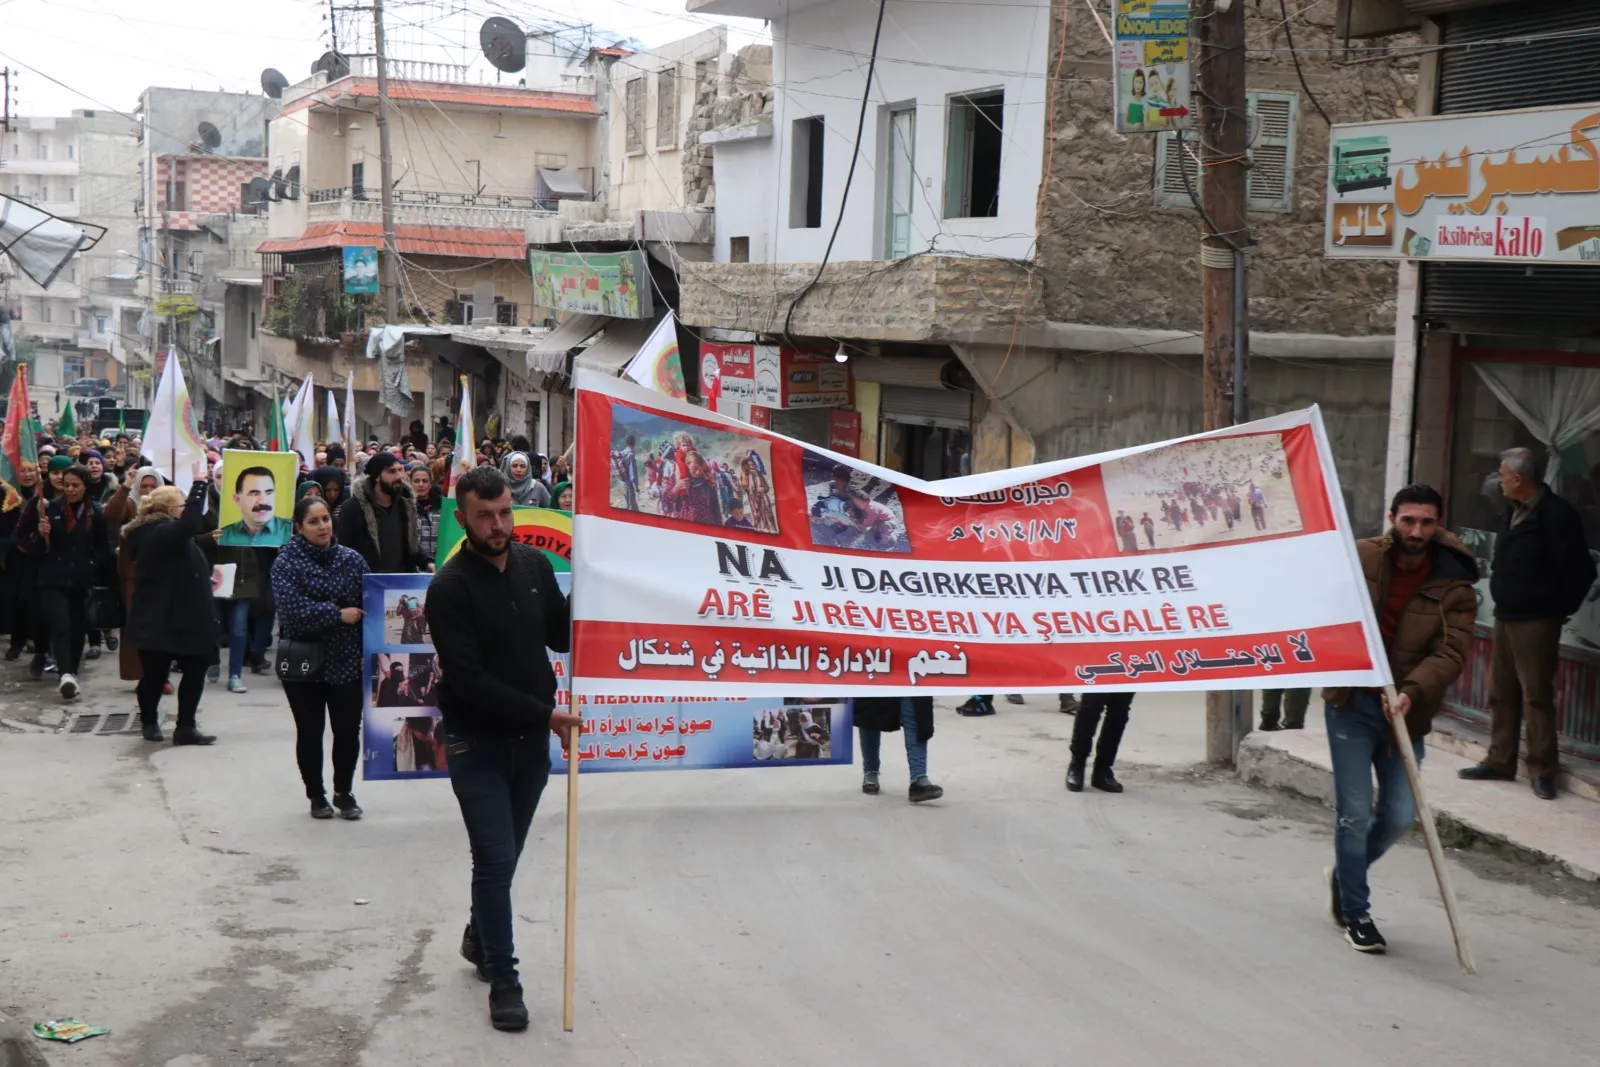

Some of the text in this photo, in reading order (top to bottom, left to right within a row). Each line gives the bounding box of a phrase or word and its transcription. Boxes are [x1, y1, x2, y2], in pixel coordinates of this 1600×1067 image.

[1117, 14, 1188, 35] KNOWLEDGE
[1335, 204, 1388, 246] كالو
[1494, 216, 1543, 258] kalo
[714, 541, 1195, 596] NA JI DAGIRKERIYA TIRK RE
[697, 588, 1230, 642] ARÊ JI RÊVEBERI YA ŞENGALÊ RE
[618, 637, 969, 685] نعم للإدارة الذاتية في شنكال
[1288, 632, 1316, 662] لا
[1075, 650, 1165, 684] التركي
[600, 714, 632, 737] المرأة
[636, 716, 675, 735] كرامة
[679, 718, 713, 736] صون
[562, 743, 687, 763] صون كرامة المرة
